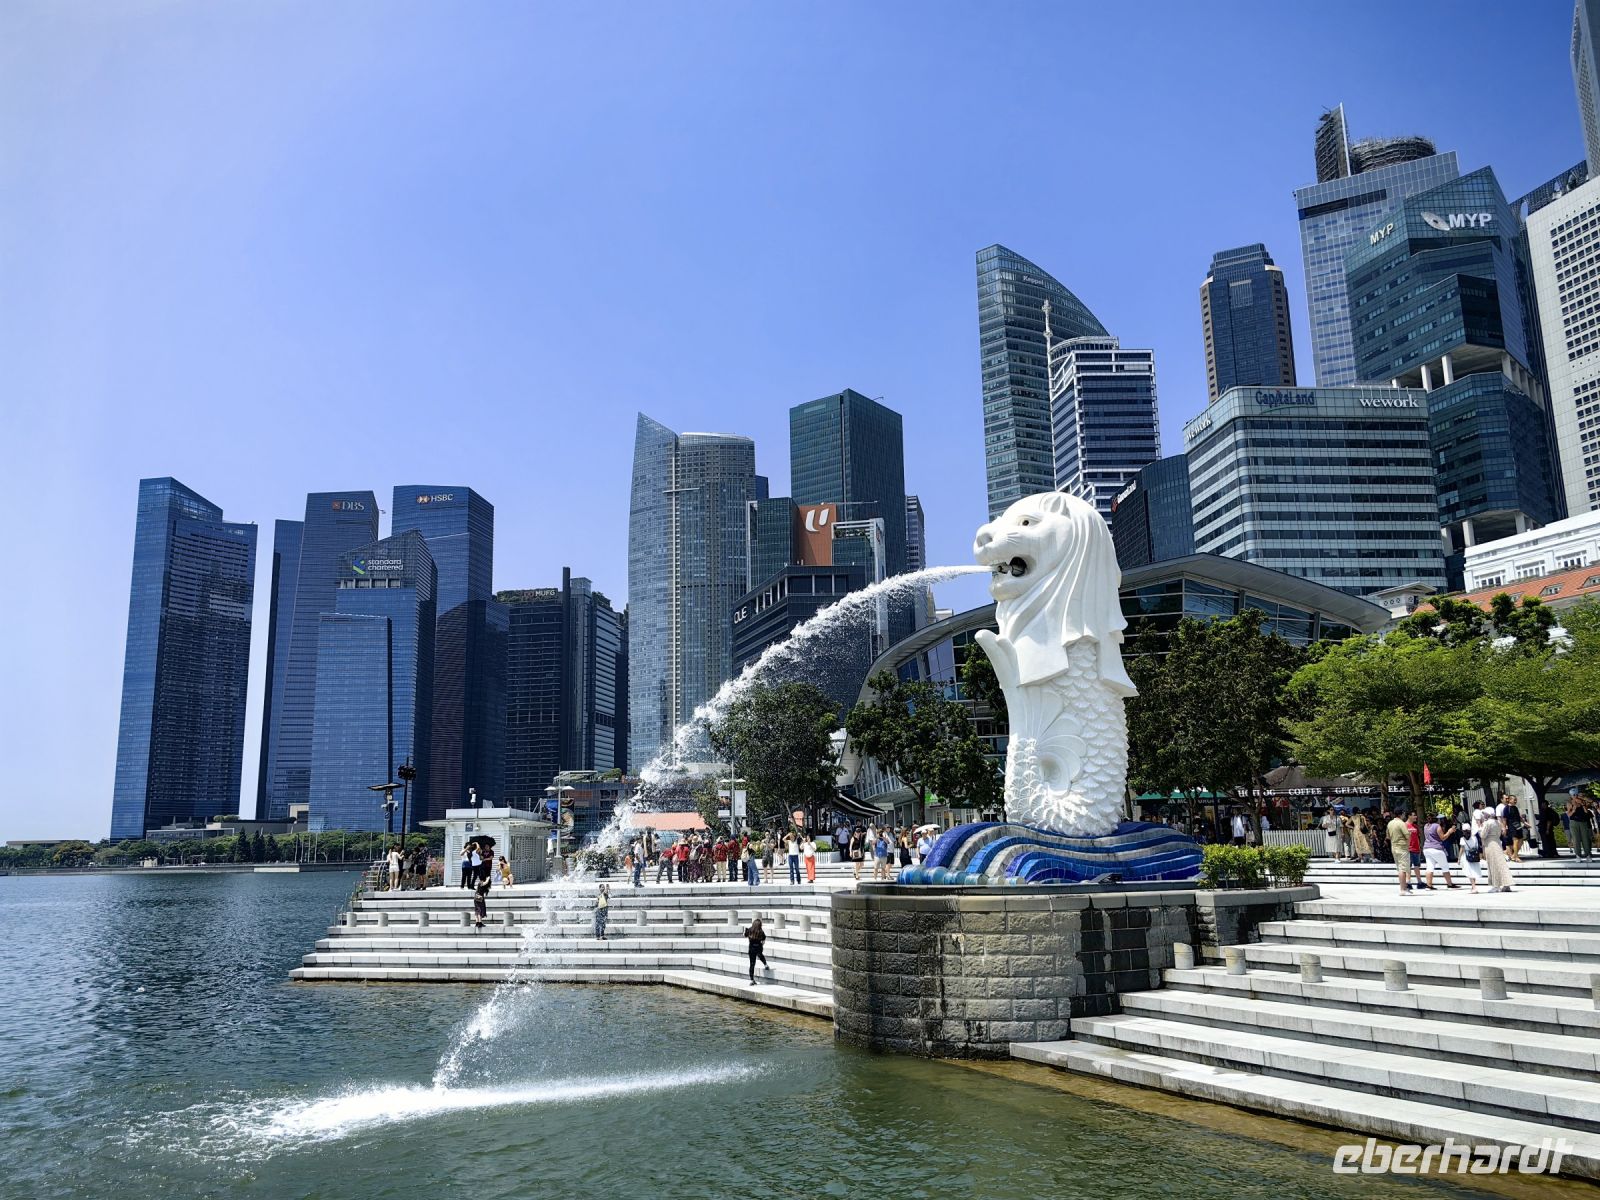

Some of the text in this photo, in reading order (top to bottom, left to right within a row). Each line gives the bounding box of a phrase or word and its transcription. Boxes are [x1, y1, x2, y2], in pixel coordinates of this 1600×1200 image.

[1448, 213, 1492, 228] MYP
[1370, 222, 1394, 245] MYP
[1359, 393, 1420, 408] wework
[431, 493, 454, 502] HSBC
[342, 500, 365, 511] DBS
[367, 558, 402, 566] standard
[367, 564, 404, 572] chartered
[535, 589, 556, 597] MUFG
[1288, 787, 1323, 796] COFFEE
[1335, 785, 1371, 795] GELATO
